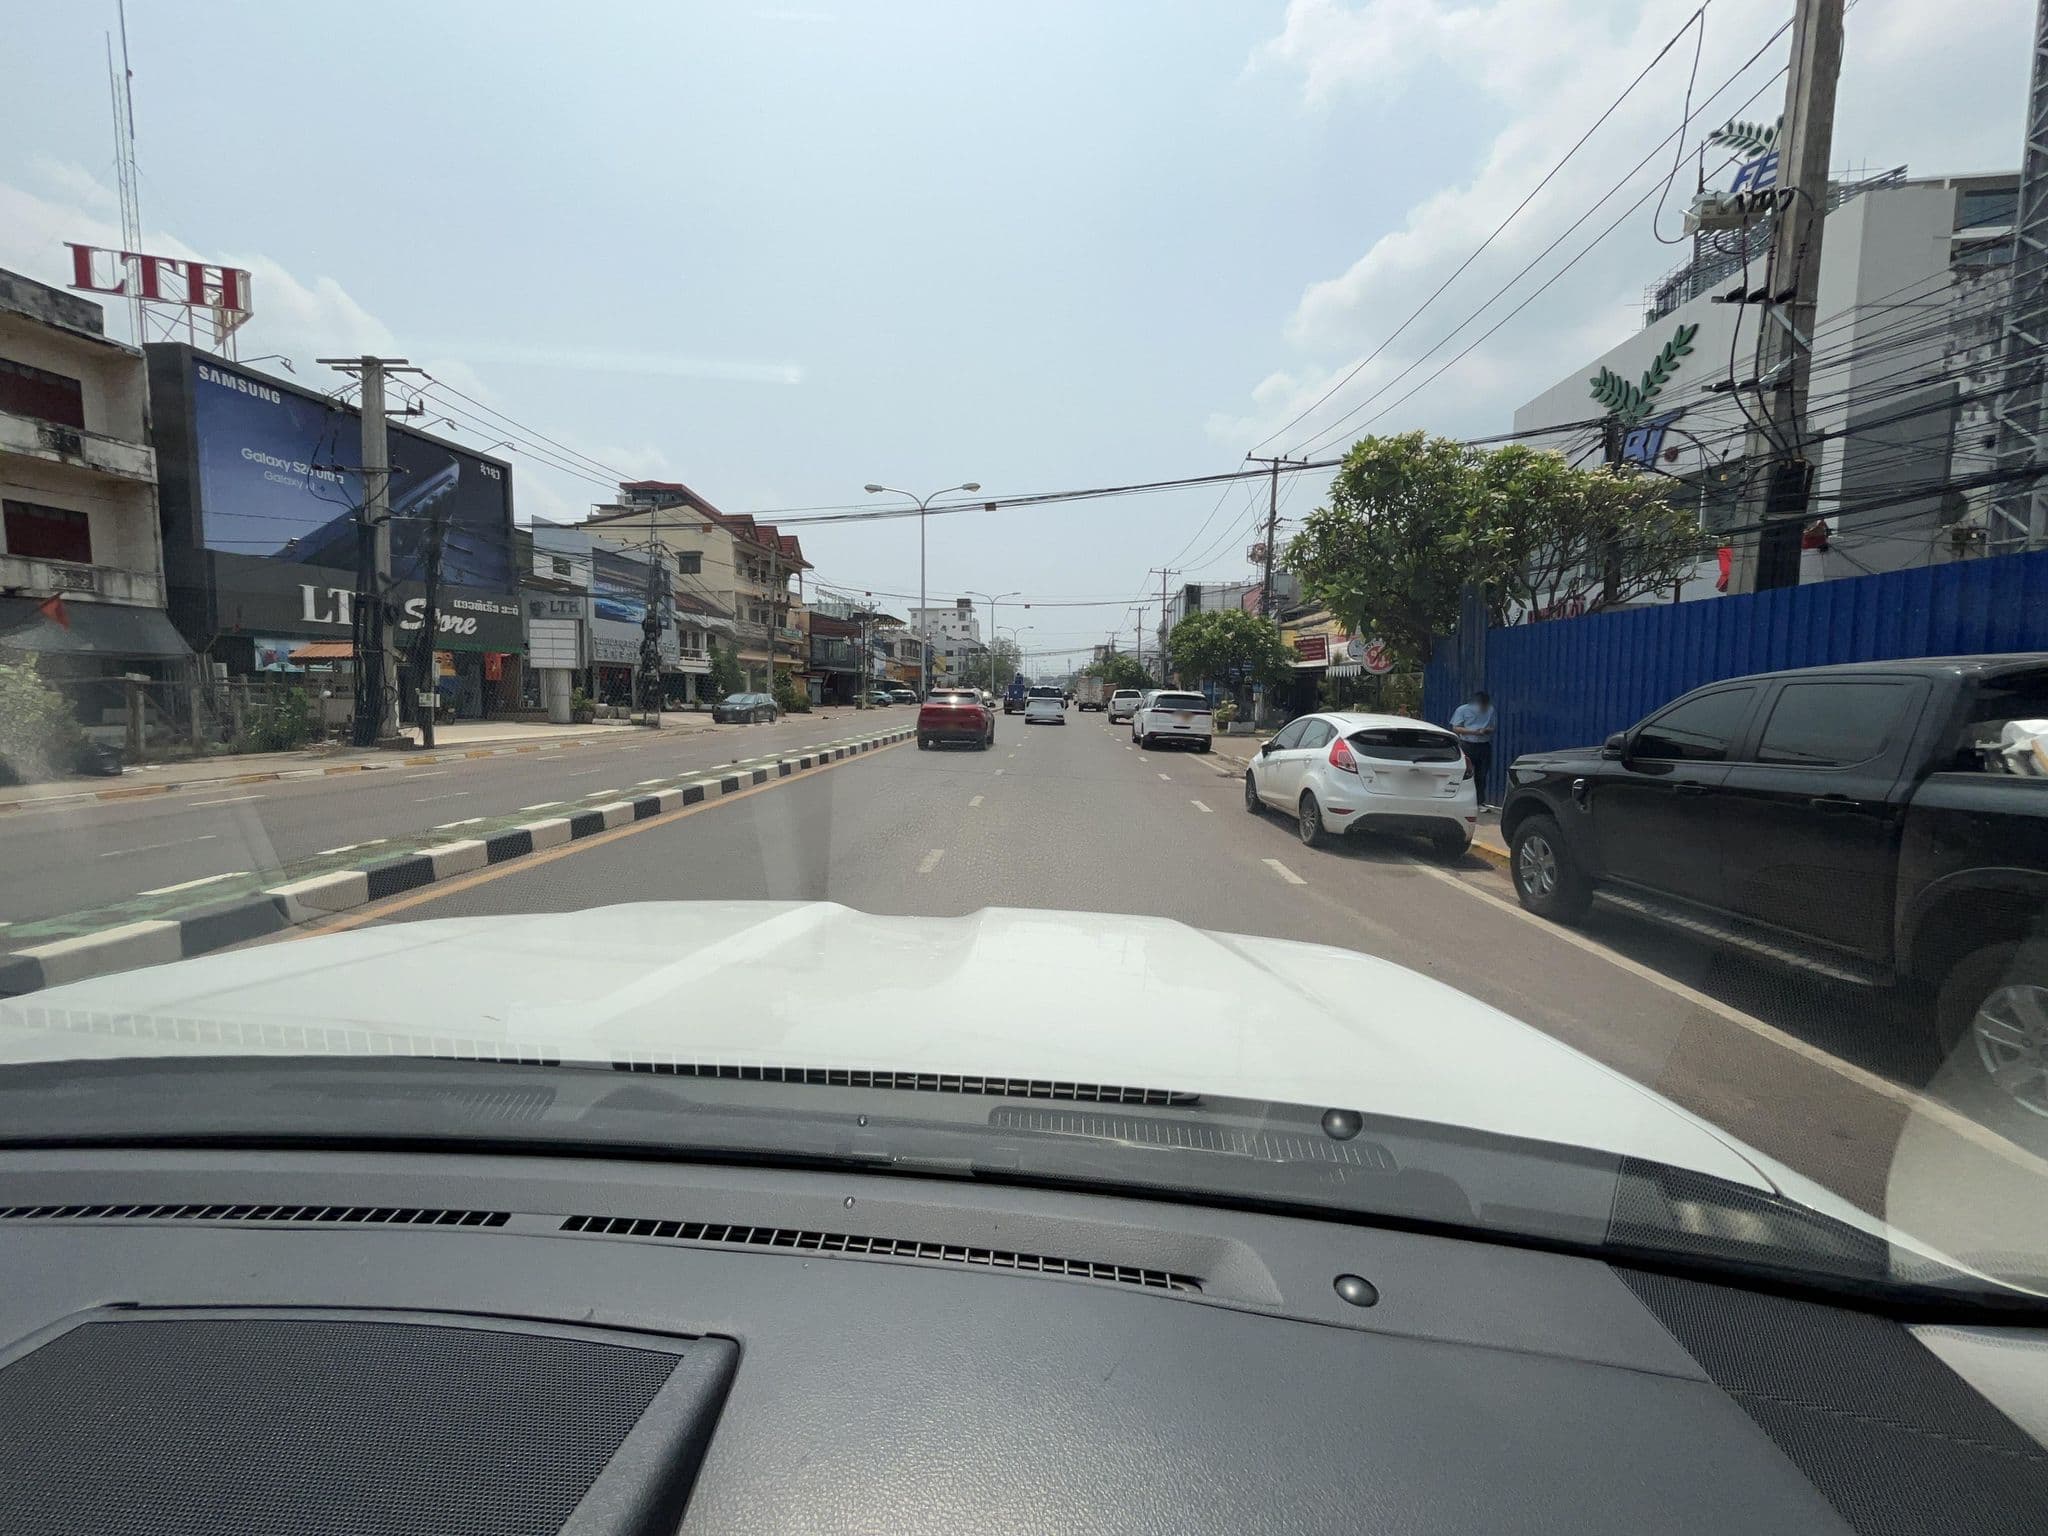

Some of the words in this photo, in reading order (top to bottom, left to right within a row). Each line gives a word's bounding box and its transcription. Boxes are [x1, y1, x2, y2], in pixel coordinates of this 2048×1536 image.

[63, 242, 250, 312] LTH
[199, 365, 281, 405] SAMSUNG
[241, 448, 291, 473] Galaxy
